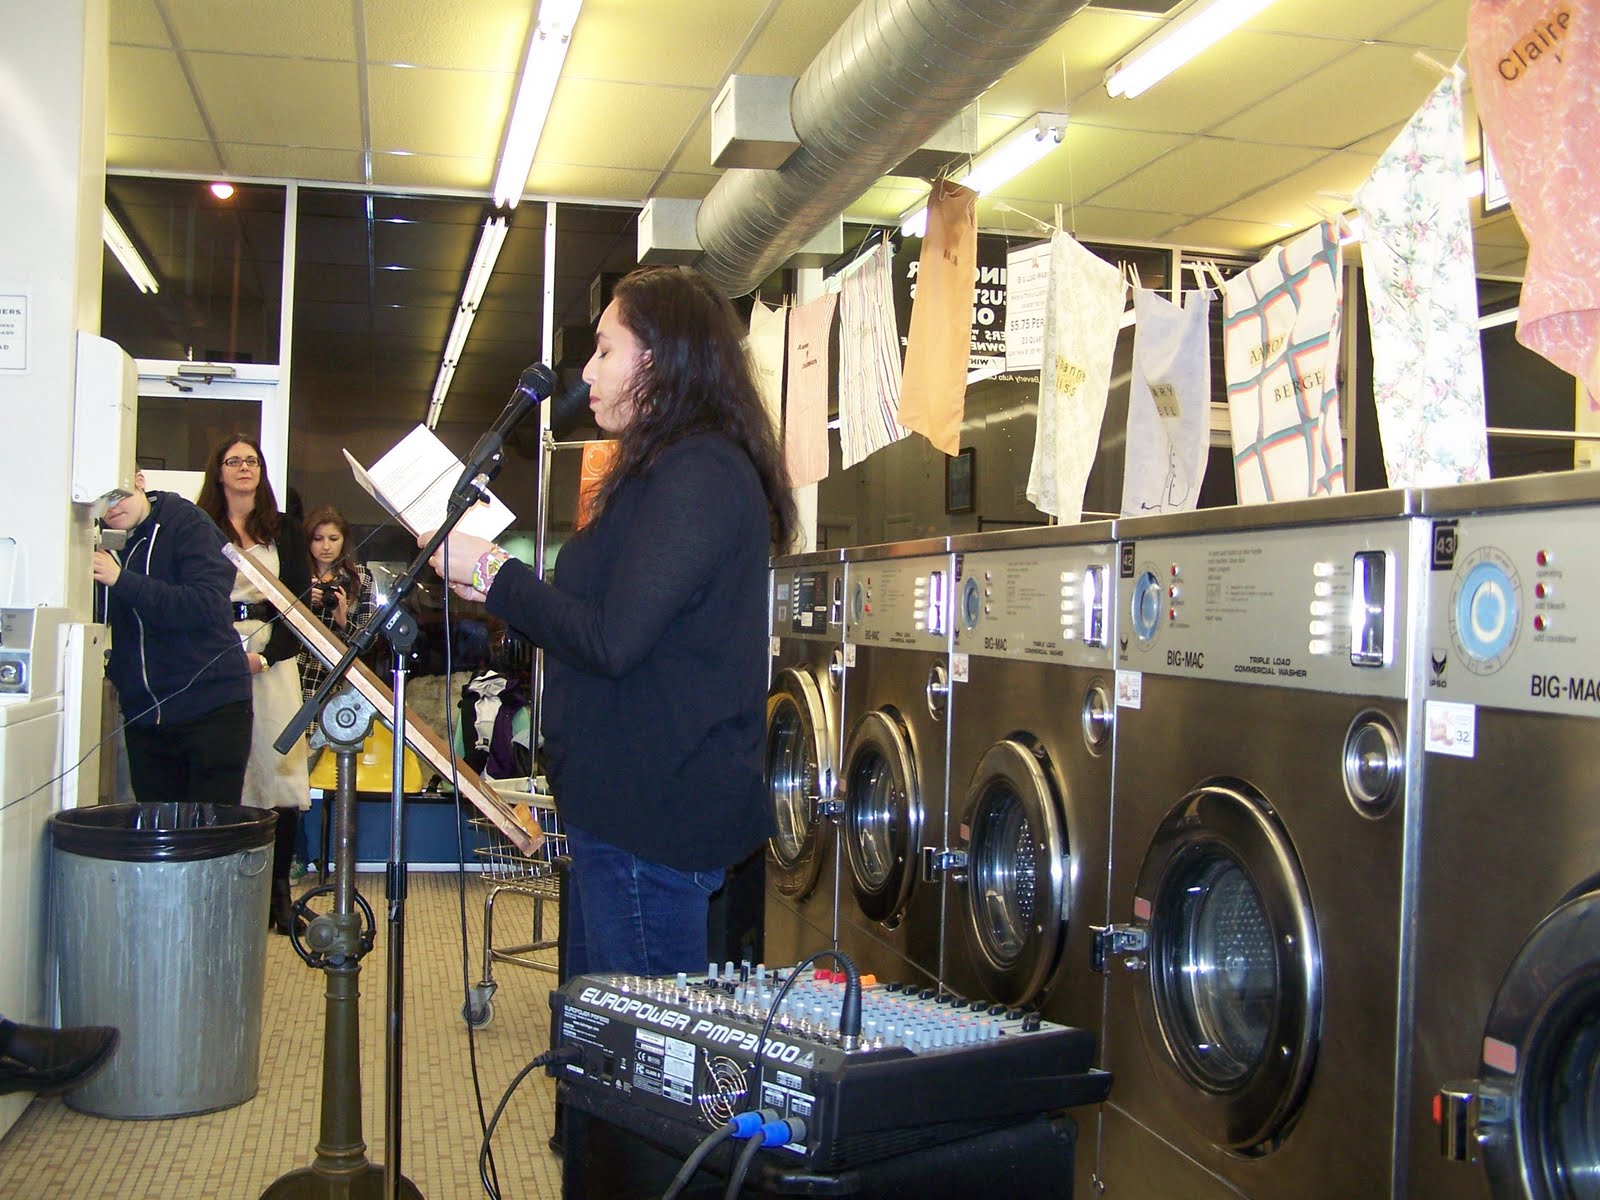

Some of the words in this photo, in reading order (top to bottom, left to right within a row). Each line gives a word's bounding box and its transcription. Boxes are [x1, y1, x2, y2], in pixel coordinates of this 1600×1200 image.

[1499, 12, 1569, 80] Claire
[1010, 319, 1030, 331] $5.75
[1152, 386, 1173, 398] ARY
[1157, 405, 1177, 416] EIL
[1437, 536, 1454, 554] 43
[984, 637, 1007, 651] BIG-MAC
[1167, 650, 1204, 669] BIG-MAC
[1249, 656, 1270, 665] TRIPLE
[1273, 657, 1291, 666] LOAD
[1234, 665, 1276, 675] COMMERCIAL
[1278, 668, 1307, 677] WASHER
[1456, 730, 1469, 742] 32
[580, 986, 690, 1031] EUROPOWER
